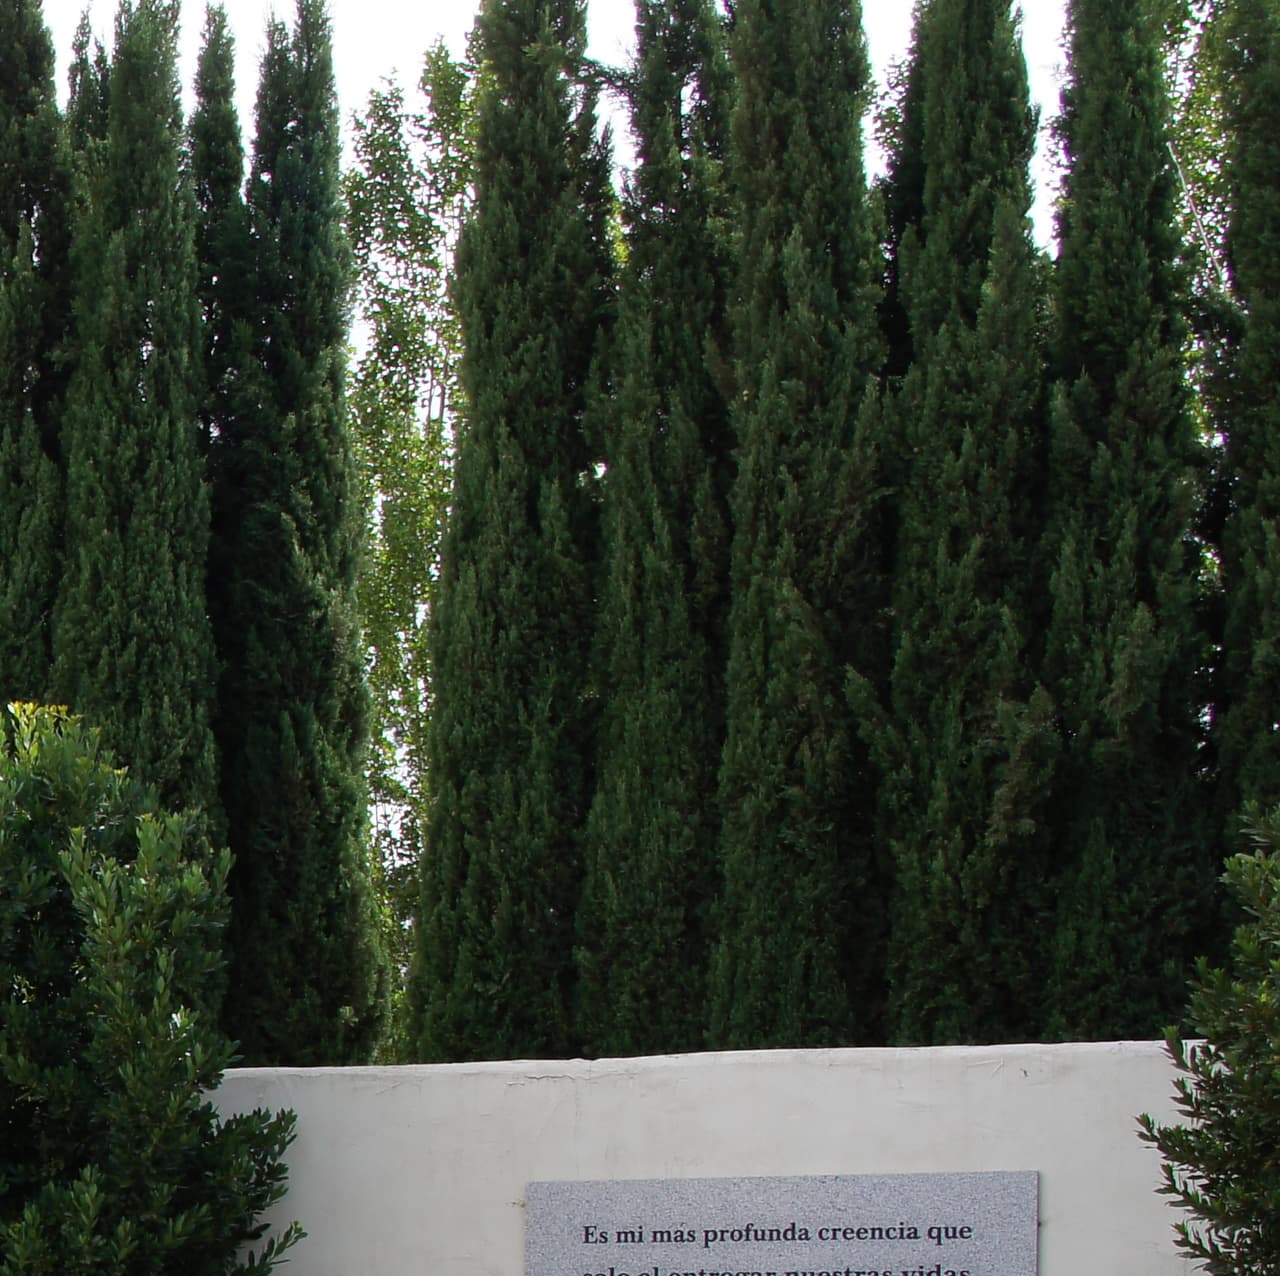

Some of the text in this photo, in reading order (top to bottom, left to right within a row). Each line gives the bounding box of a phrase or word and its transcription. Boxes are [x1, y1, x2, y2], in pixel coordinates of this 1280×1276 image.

[582, 1221, 972, 1249] Es mi más profunda creencia que
